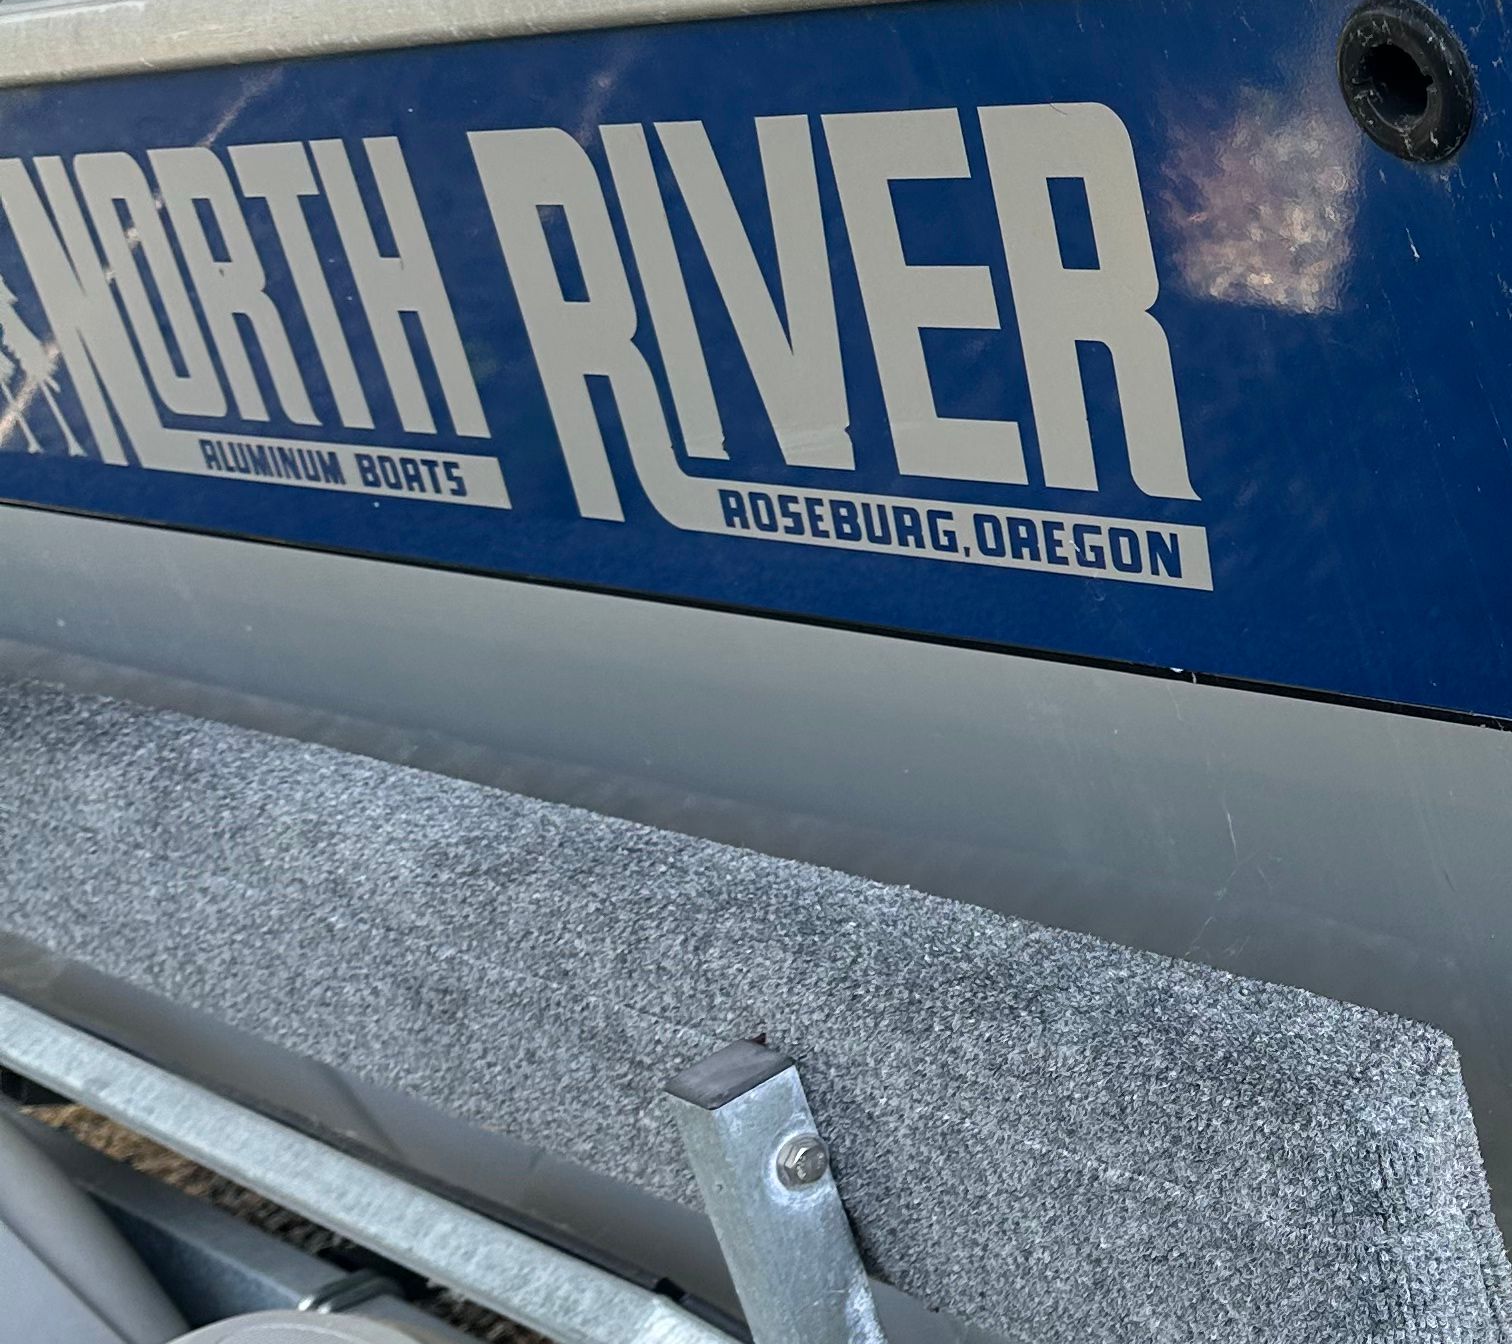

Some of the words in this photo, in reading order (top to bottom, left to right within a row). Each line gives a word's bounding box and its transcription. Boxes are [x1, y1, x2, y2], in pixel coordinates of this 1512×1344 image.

[0, 136, 492, 469] NORTH
[466, 101, 1202, 525] RIVER
[199, 438, 347, 485] ALUMINUM
[353, 453, 469, 497] BOATS
